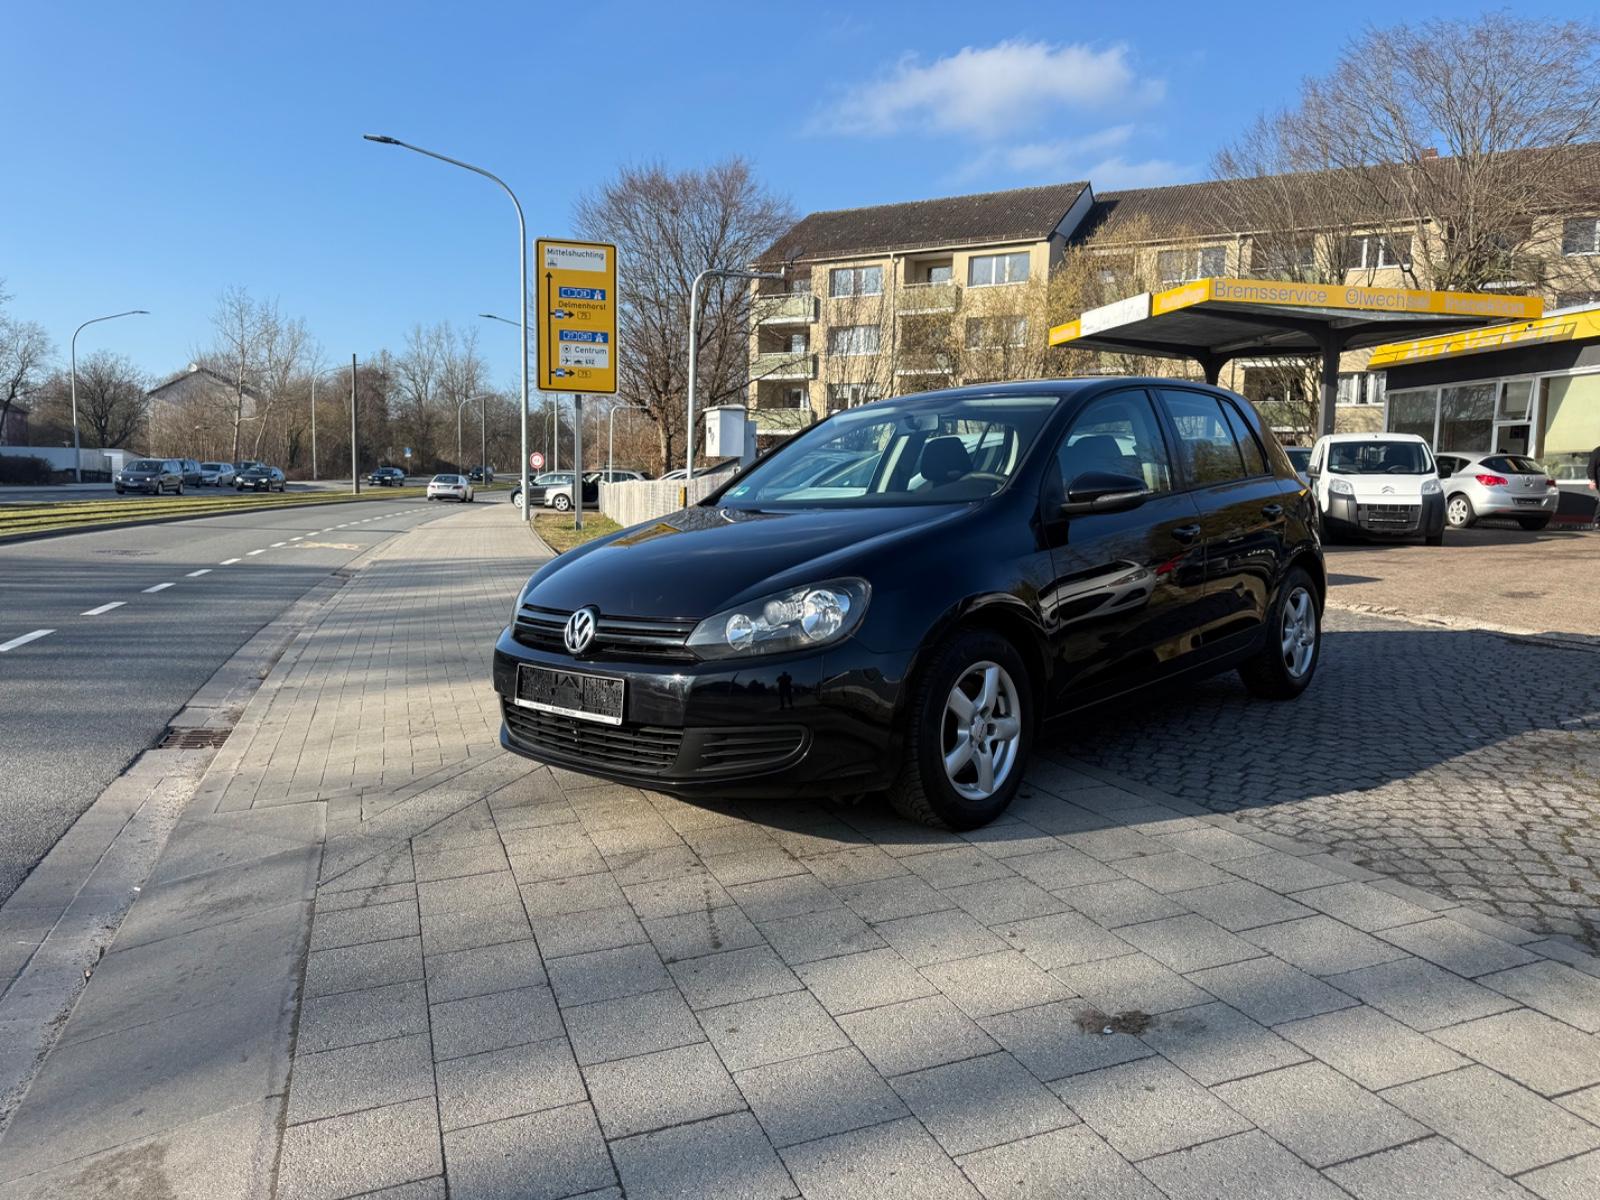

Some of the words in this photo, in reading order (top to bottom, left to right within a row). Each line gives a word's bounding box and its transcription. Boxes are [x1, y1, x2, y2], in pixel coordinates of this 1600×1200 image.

[547, 248, 604, 260] Mittelshuchting
[1214, 281, 1327, 303] Bremsservice
[558, 301, 606, 310] Delmenhorst
[574, 346, 607, 355] Centrum
